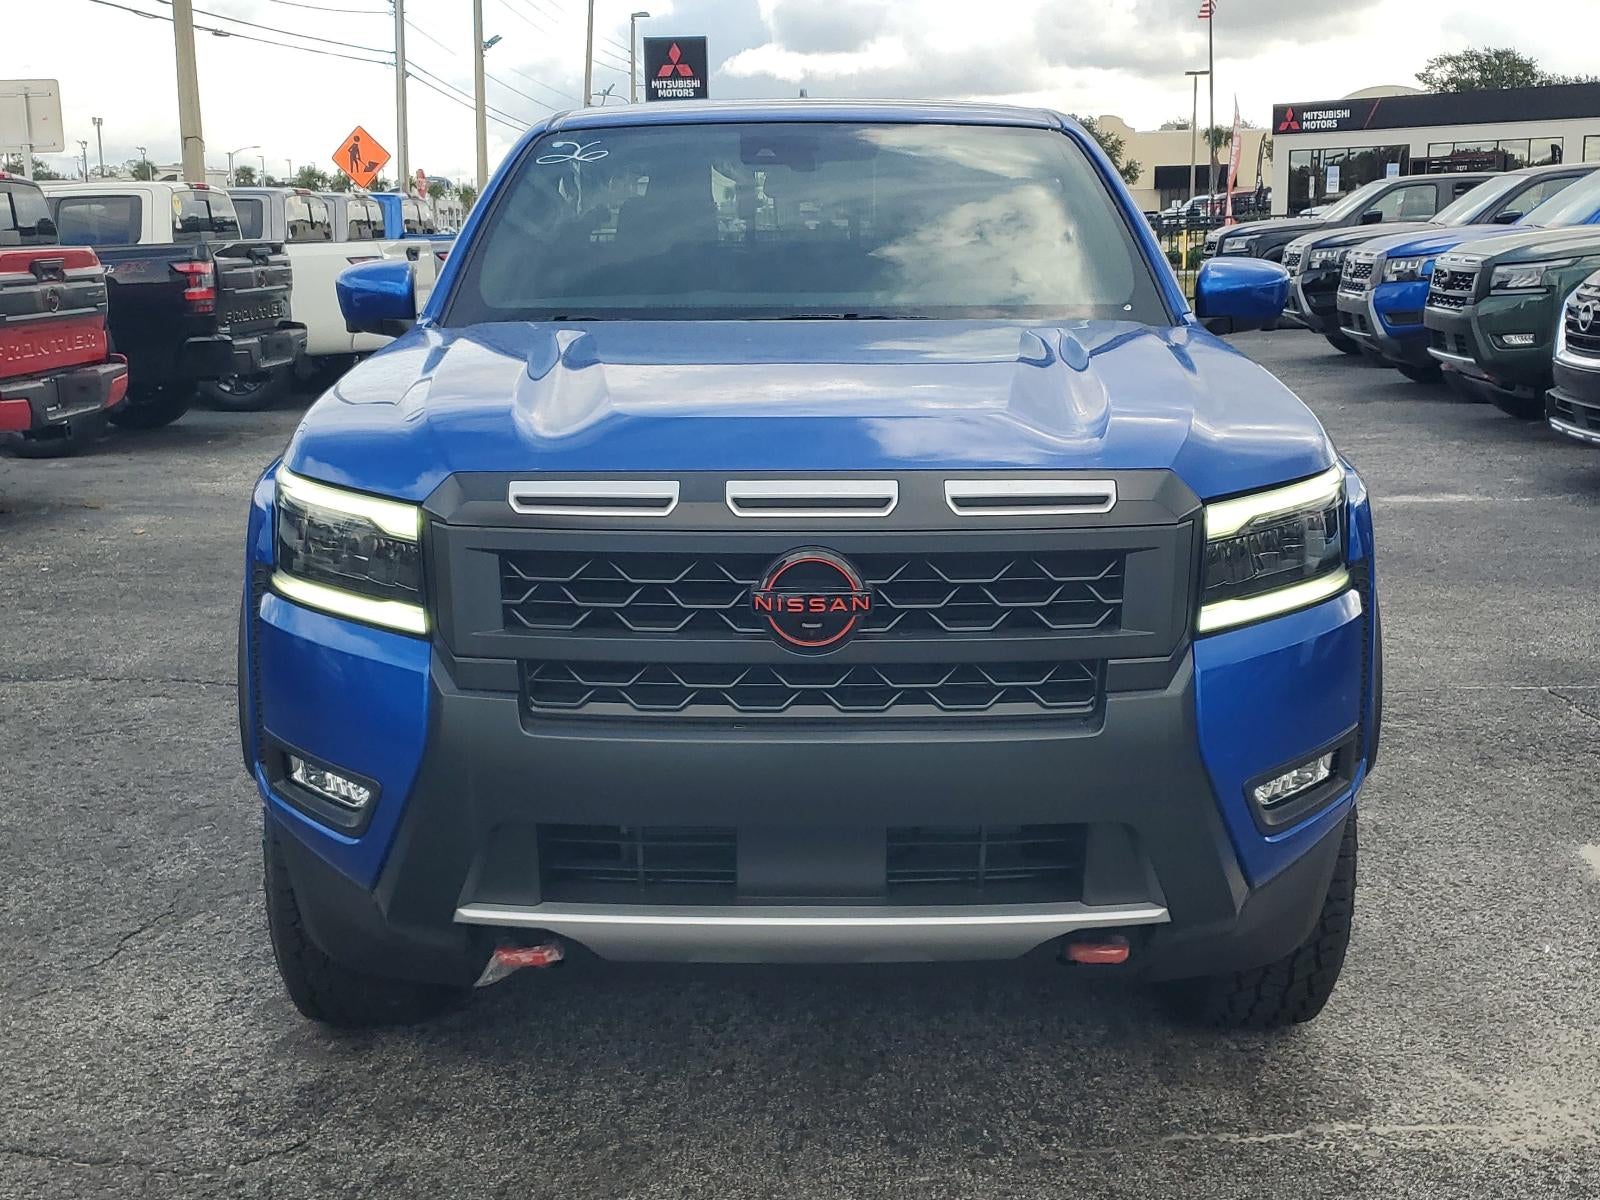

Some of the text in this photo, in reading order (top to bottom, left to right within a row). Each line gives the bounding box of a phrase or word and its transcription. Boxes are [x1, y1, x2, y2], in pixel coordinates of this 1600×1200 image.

[651, 79, 701, 89] MITSUBISHI
[658, 88, 695, 98] MOTORS
[1302, 109, 1351, 120] MITSUBISHI
[1302, 119, 1338, 130] MOTORS
[536, 141, 608, 164] 26
[754, 596, 870, 612] NISSAN
